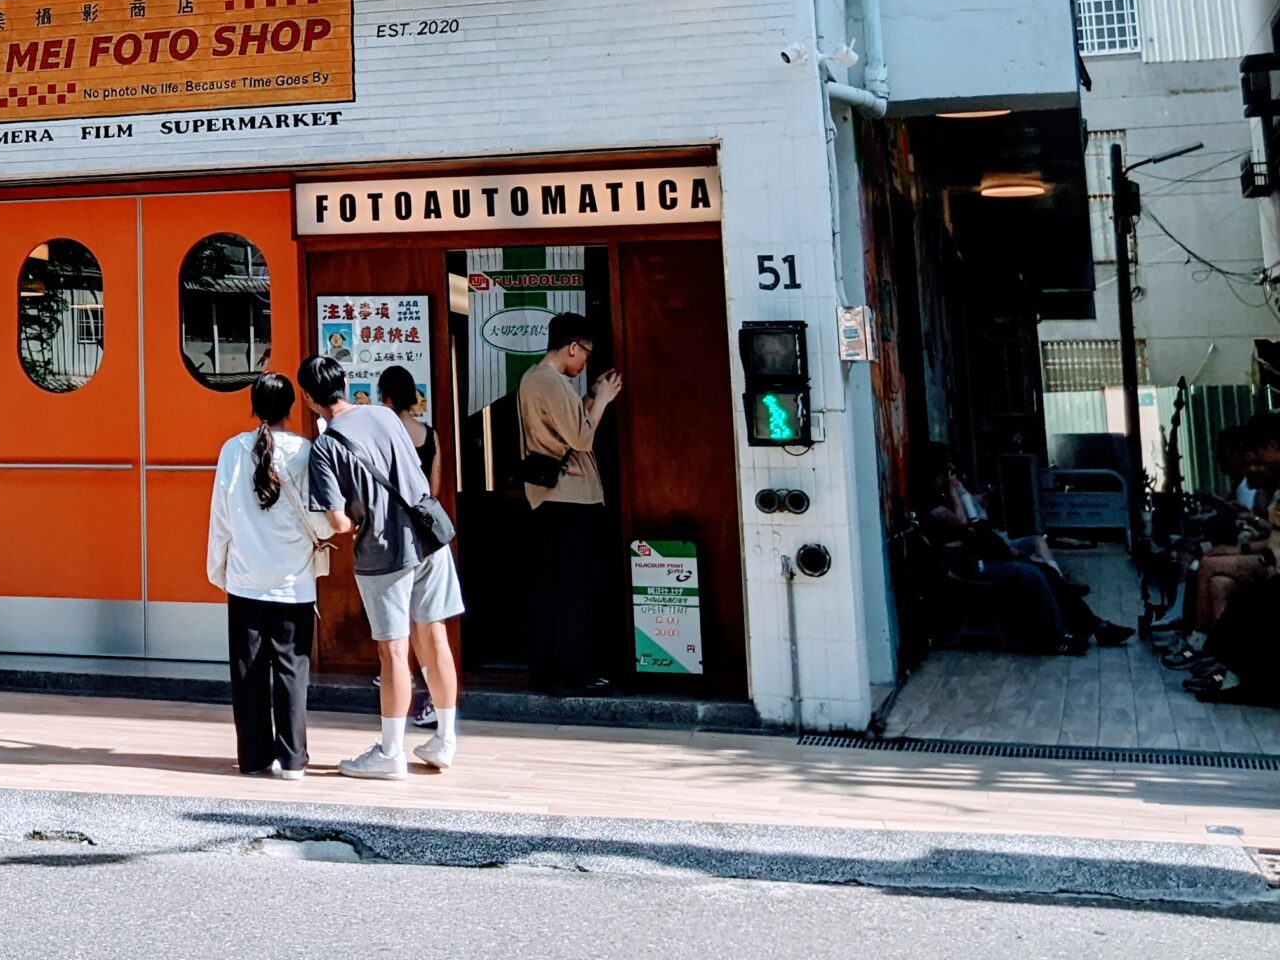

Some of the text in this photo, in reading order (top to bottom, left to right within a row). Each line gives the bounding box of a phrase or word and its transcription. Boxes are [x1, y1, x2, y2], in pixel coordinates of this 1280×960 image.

[376, 20, 459, 38] EST. 2020
[6, 39, 76, 72] MEI
[89, 29, 198, 67] FOTO
[212, 18, 332, 56] SHOP
[84, 88, 98, 100] No
[103, 85, 137, 100] photo
[141, 84, 157, 95] No
[185, 78, 236, 92] Because
[241, 76, 271, 88] Time
[275, 74, 308, 86] Goes
[81, 123, 132, 140] FILM
[160, 111, 342, 135] SUPERMARKET
[315, 177, 712, 223] FOTOAUTOMATICA
[492, 274, 583, 287] FUJICOLOR
[757, 254, 801, 290] 51
[323, 302, 390, 320] 注意事項
